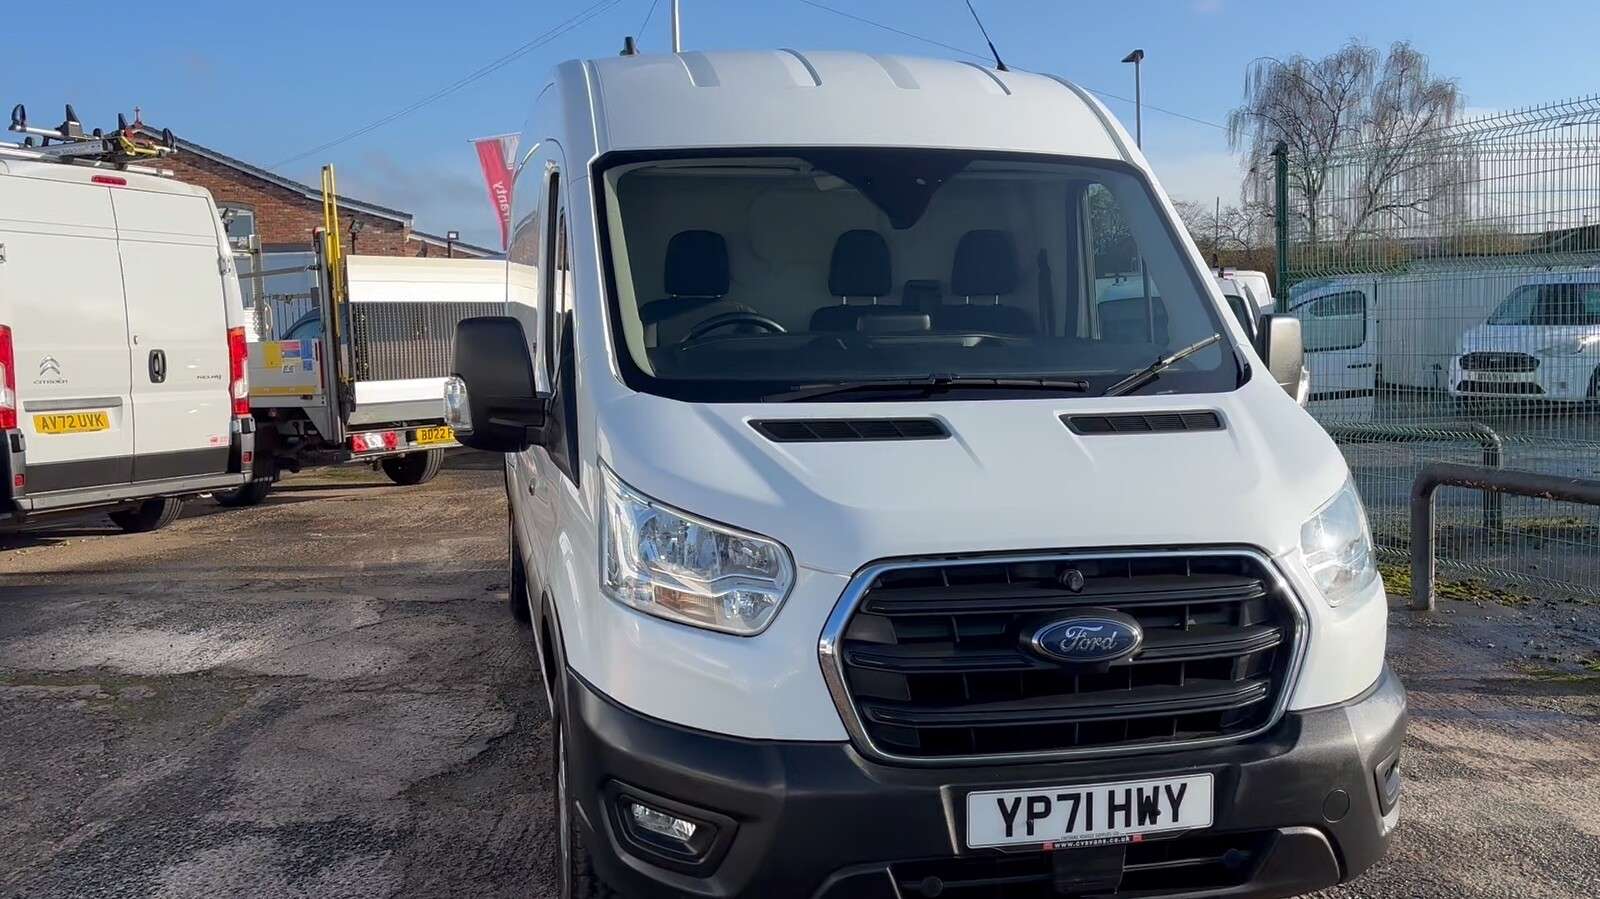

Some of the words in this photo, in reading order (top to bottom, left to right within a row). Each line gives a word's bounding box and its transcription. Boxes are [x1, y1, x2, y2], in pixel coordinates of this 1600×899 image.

[41, 415, 76, 430] AV72
[78, 414, 105, 428] UVK
[421, 428, 446, 441] BD22
[1061, 625, 1117, 652] Ford
[997, 791, 1094, 838] YP71
[1107, 782, 1188, 830] HWY
